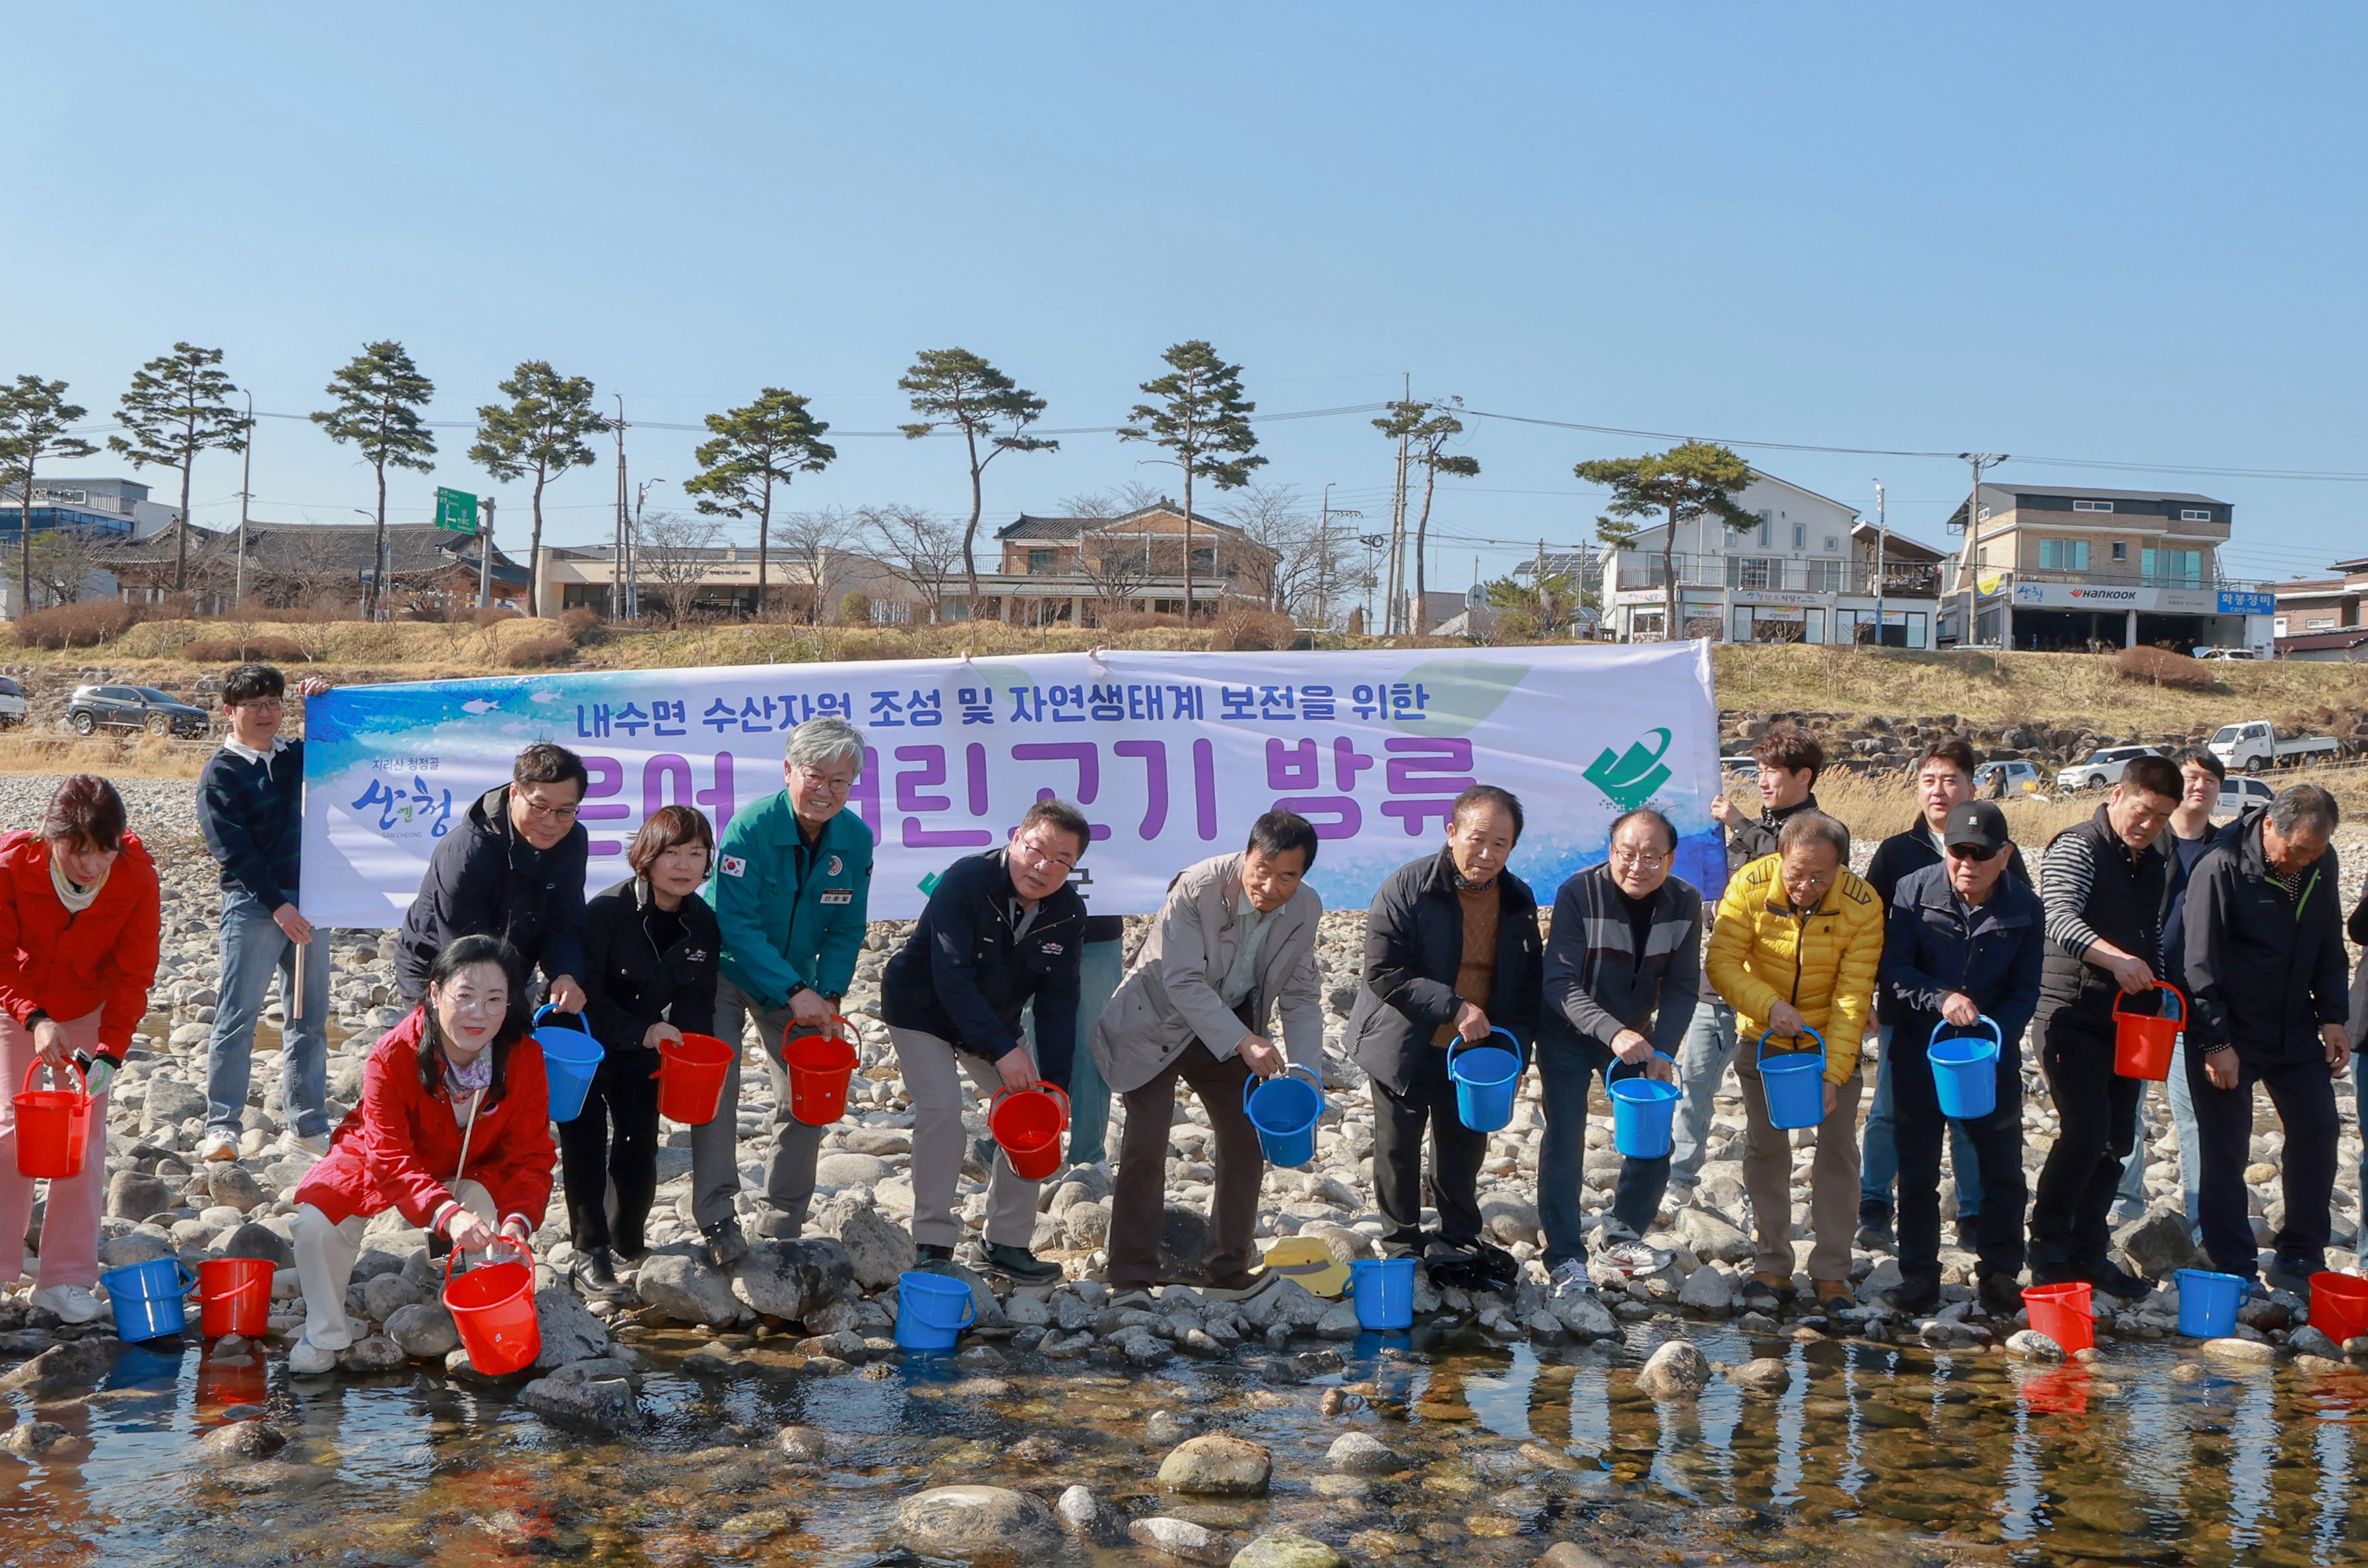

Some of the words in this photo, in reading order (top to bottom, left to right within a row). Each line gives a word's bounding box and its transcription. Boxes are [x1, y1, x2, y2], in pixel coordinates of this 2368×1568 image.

[577, 700, 686, 738] 내수면
[702, 692, 852, 734] 수산자원
[869, 688, 943, 727] 조성
[958, 688, 995, 725] 및
[1008, 684, 1204, 723] 자연생태계
[1221, 685, 1336, 721] 보전을
[1352, 683, 1431, 721] 위한
[372, 758, 404, 771] 지리산
[407, 757, 440, 771] 청정골
[1265, 736, 1478, 841] 방류
